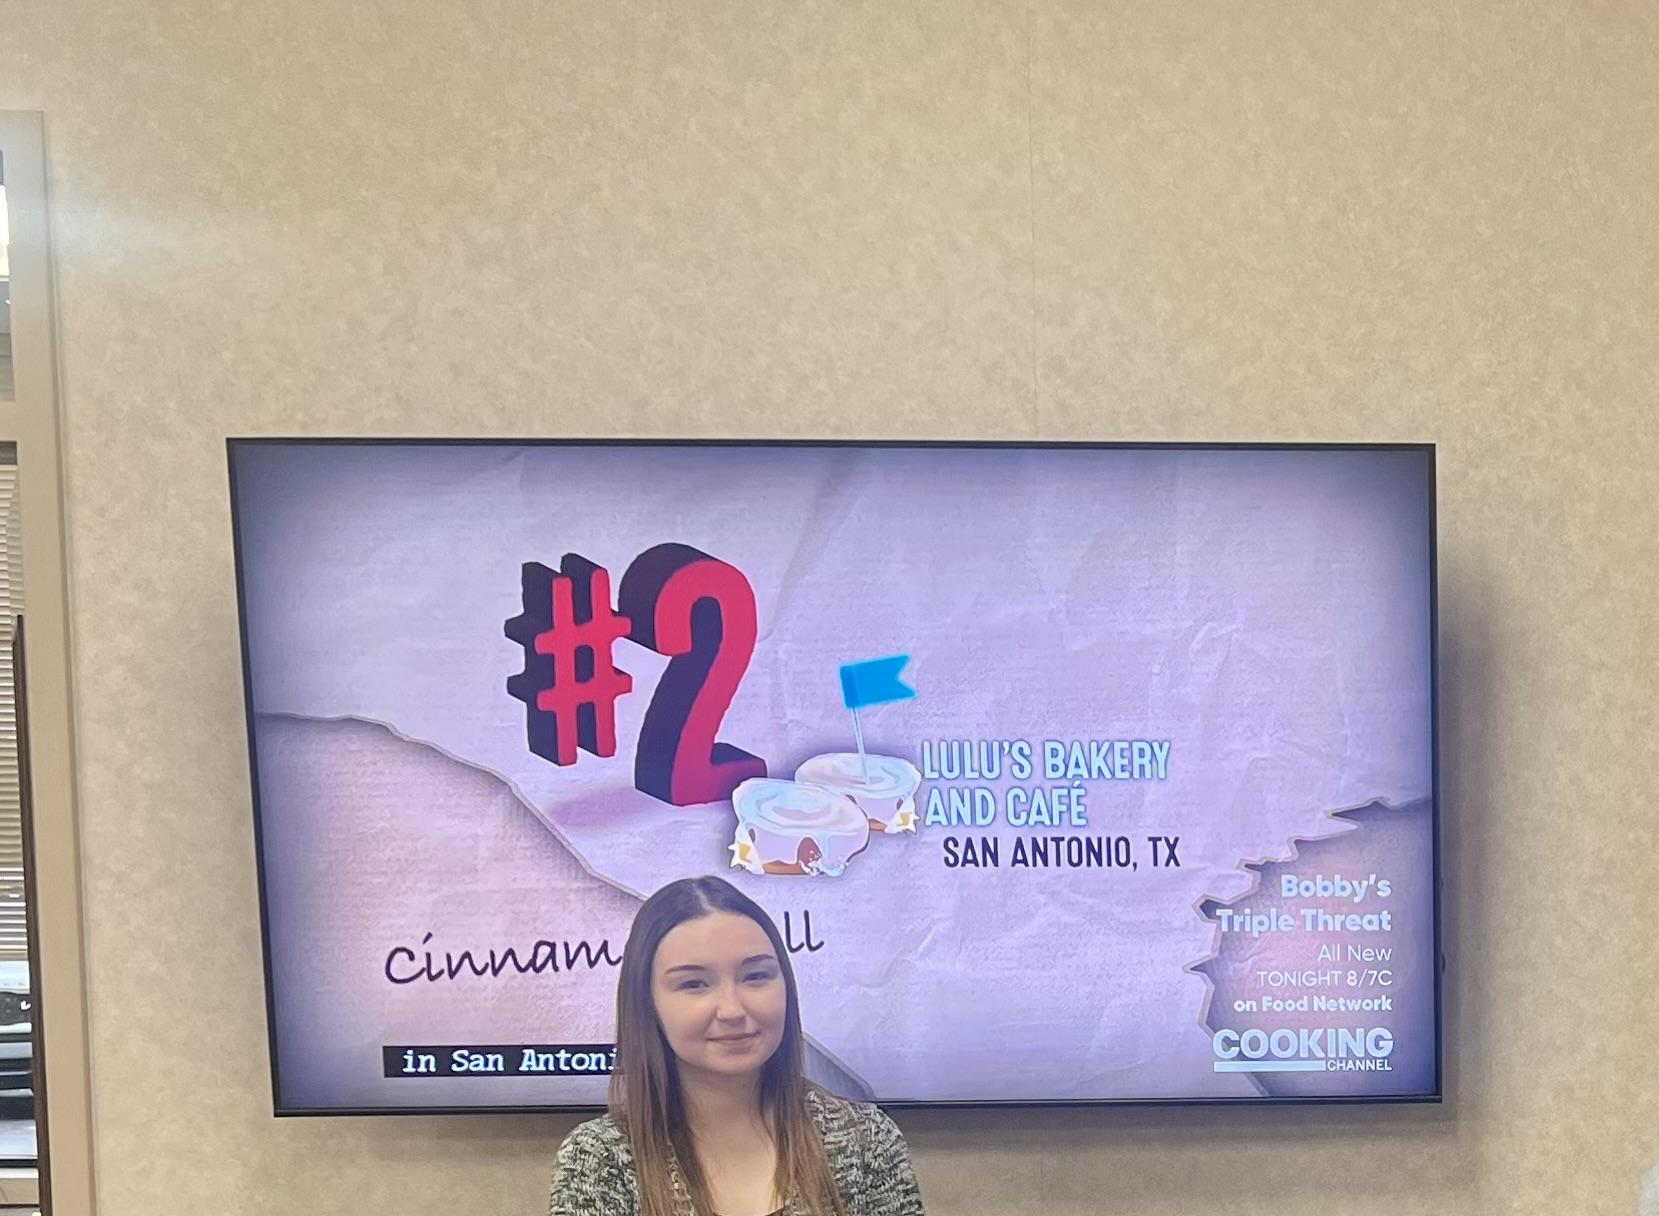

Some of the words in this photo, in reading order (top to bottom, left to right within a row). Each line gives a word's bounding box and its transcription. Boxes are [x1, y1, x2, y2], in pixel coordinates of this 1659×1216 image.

[505, 543, 767, 806] #2
[923, 739, 1031, 781] LULU'S
[1044, 739, 1171, 780] BAKERY
[925, 787, 995, 827] AND
[1006, 780, 1087, 827] CAFÉ
[943, 836, 999, 868] SAN
[1011, 835, 1138, 872] ANTONIO,
[1147, 836, 1181, 868] TX
[1281, 874, 1392, 903] Bobby's
[1216, 908, 1295, 938] Triple
[1301, 908, 1392, 932] Threat
[1318, 944, 1341, 962] All
[1347, 944, 1392, 962] New
[1257, 971, 1342, 986] TONIGHT
[1346, 970, 1393, 988] 8/7C
[1234, 998, 1257, 1012] on
[1262, 997, 1308, 1012] Food
[1313, 995, 1393, 1012] Network
[1212, 1027, 1394, 1059] COOKING
[402, 1047, 436, 1072] in
[451, 1048, 504, 1073] San
[519, 1047, 617, 1073] Antoni
[1327, 1060, 1393, 1071] CHANNEL
